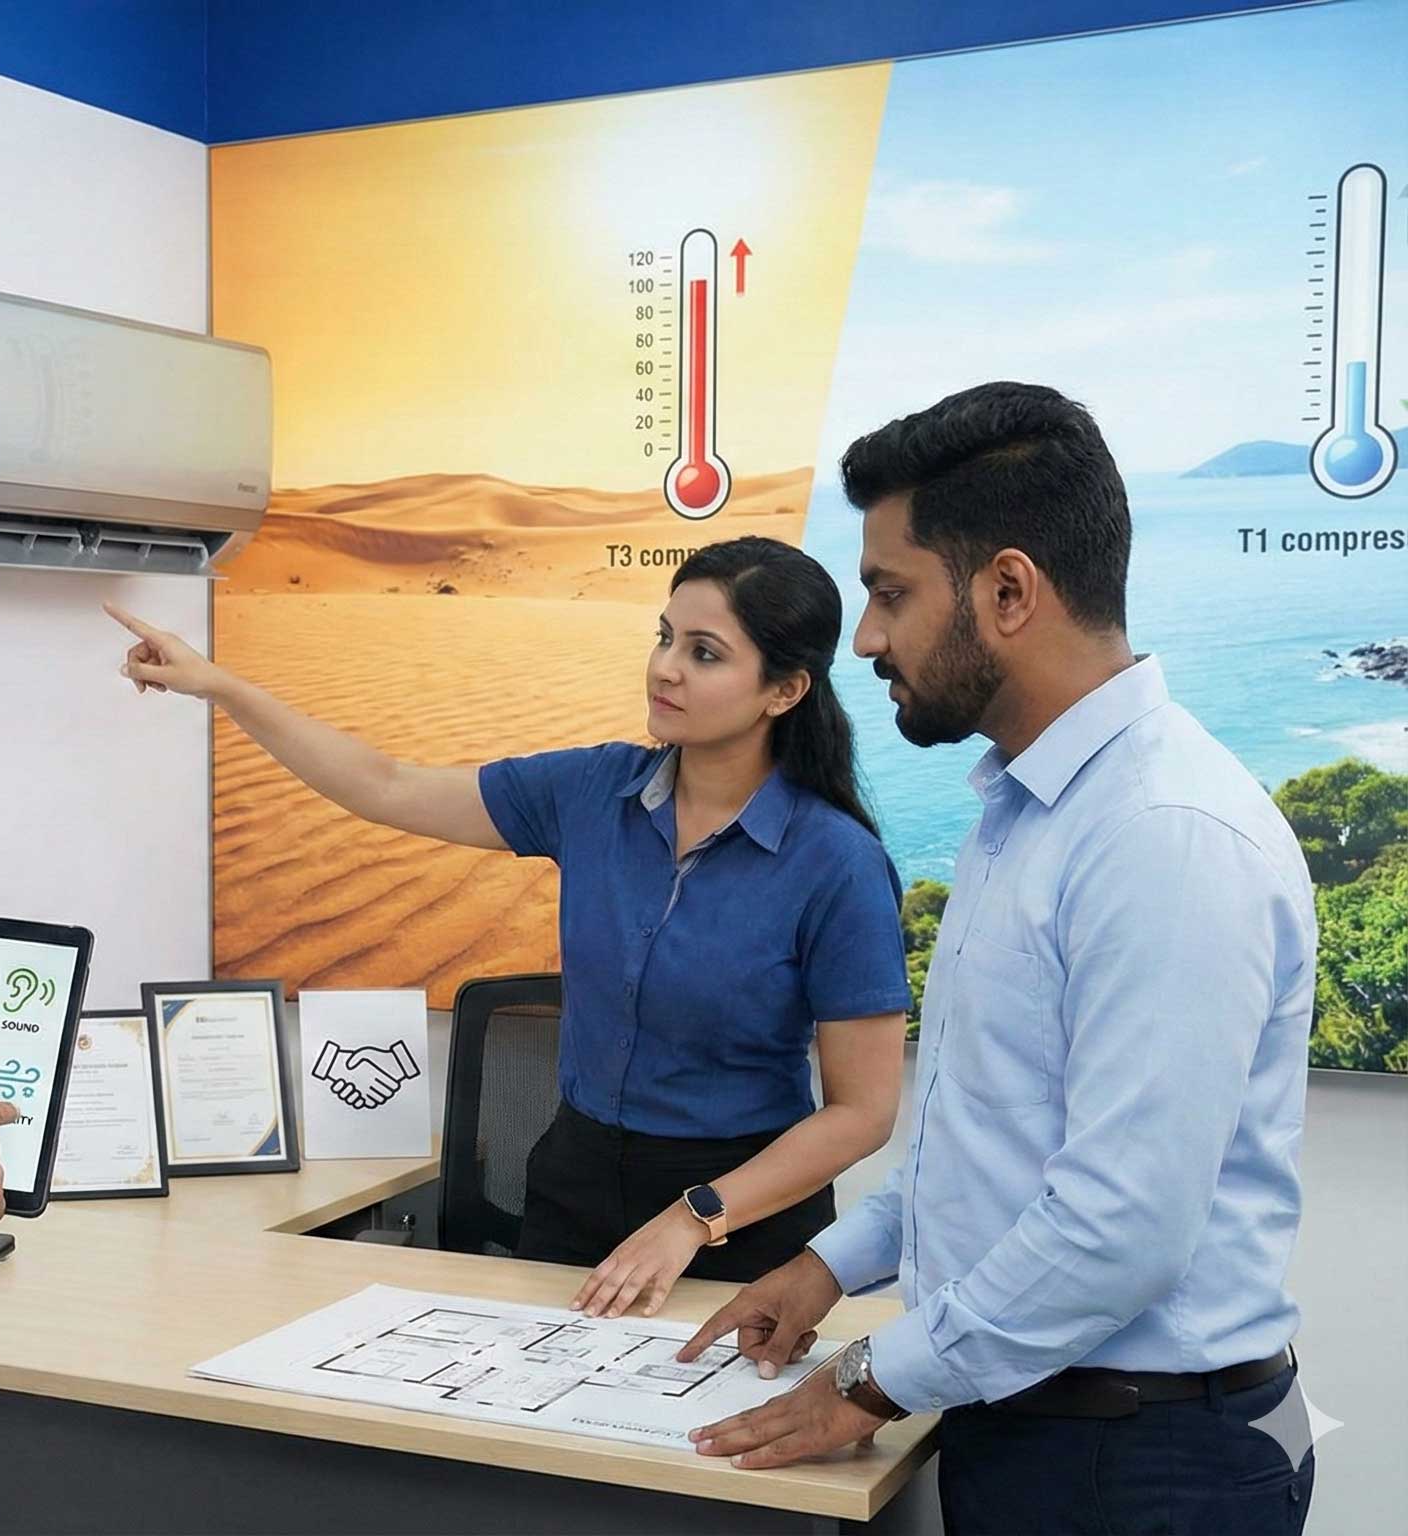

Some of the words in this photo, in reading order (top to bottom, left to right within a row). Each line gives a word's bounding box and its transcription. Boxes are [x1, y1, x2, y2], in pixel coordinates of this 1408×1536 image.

[628, 251, 654, 266] 120
[629, 278, 654, 293] 100
[635, 305, 654, 321] 80
[635, 360, 654, 375] 60
[635, 387, 654, 402] 40
[635, 414, 654, 430] 20
[644, 442, 654, 457] 0
[1237, 528, 1267, 553] T1
[1281, 529, 1408, 557] compres
[606, 544, 633, 567] T3
[1, 1020, 40, 1033] SOUND
